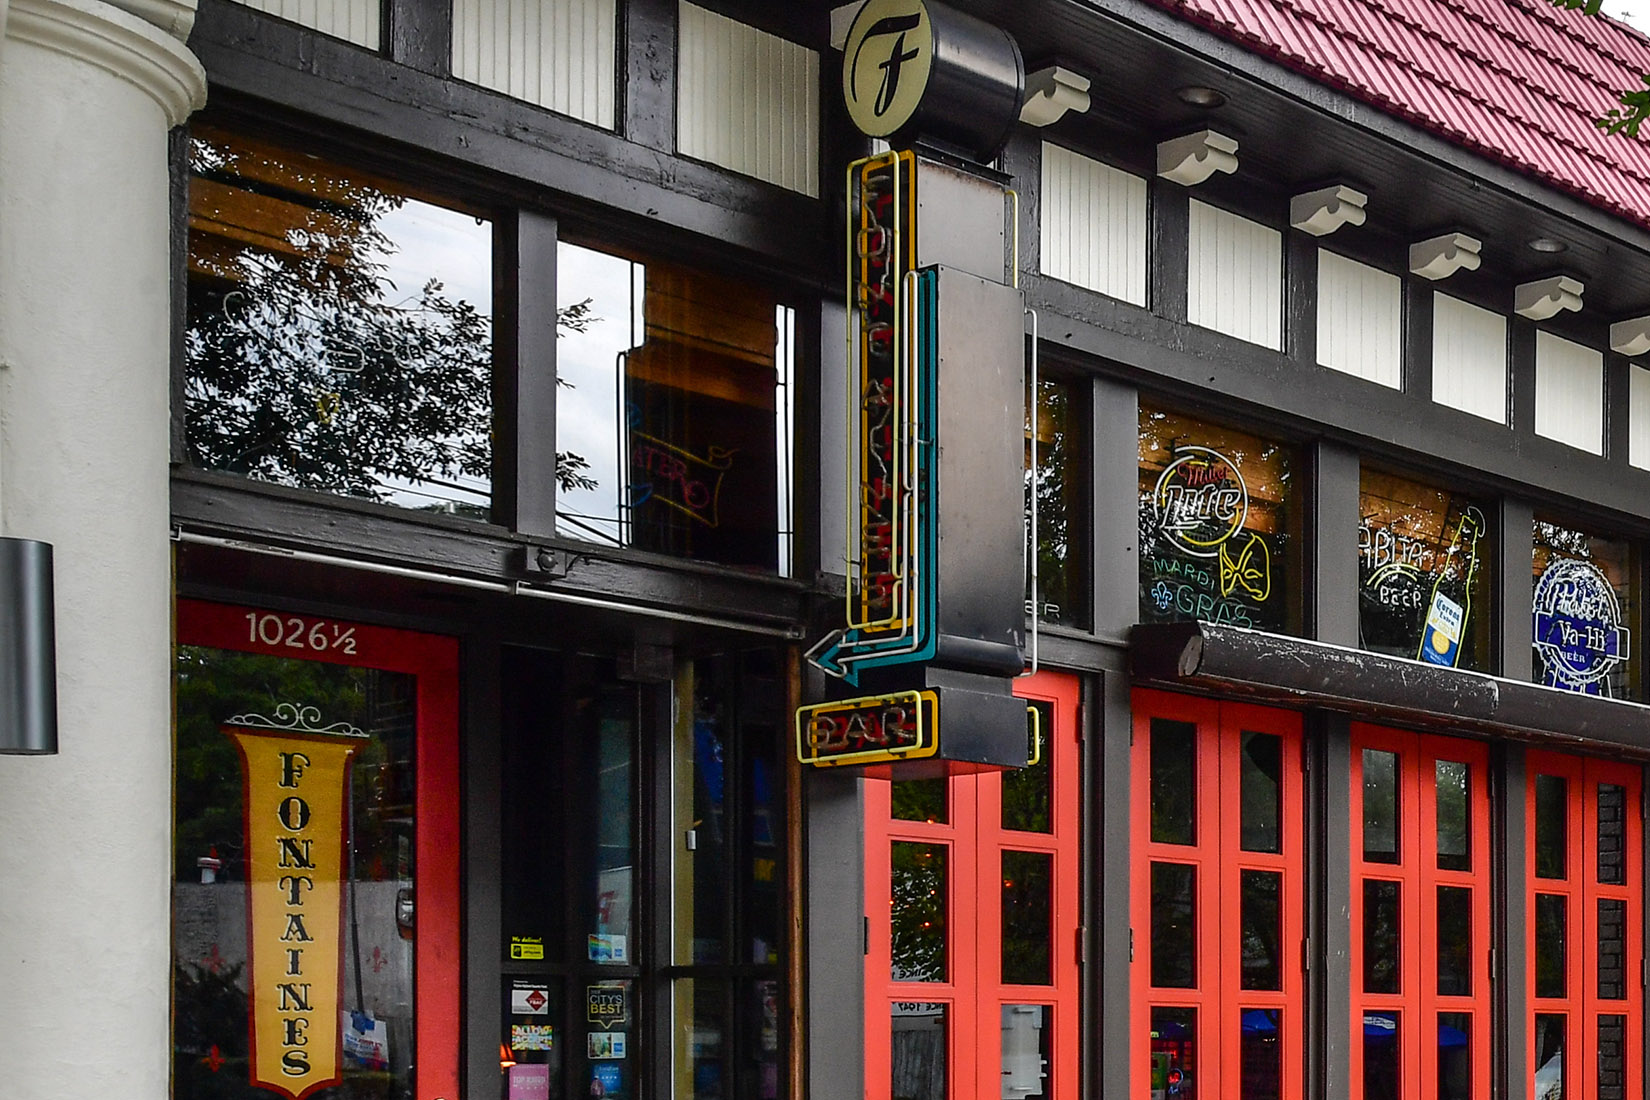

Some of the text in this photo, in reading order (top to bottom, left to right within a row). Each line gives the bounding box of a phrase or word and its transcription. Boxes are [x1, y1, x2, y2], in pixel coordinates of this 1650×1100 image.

[1177, 463, 1230, 486] Miller
[1159, 484, 1241, 530] Lite
[1153, 558, 1215, 591] MARDI
[1176, 584, 1253, 630] GRAS
[1380, 585, 1422, 610] BEER
[1436, 597, 1460, 621] Corona
[807, 704, 918, 750] BAR
[277, 751, 316, 1079] FONTAINES
[589, 994, 623, 1004] CITY'S
[590, 1003, 622, 1014] BEST
